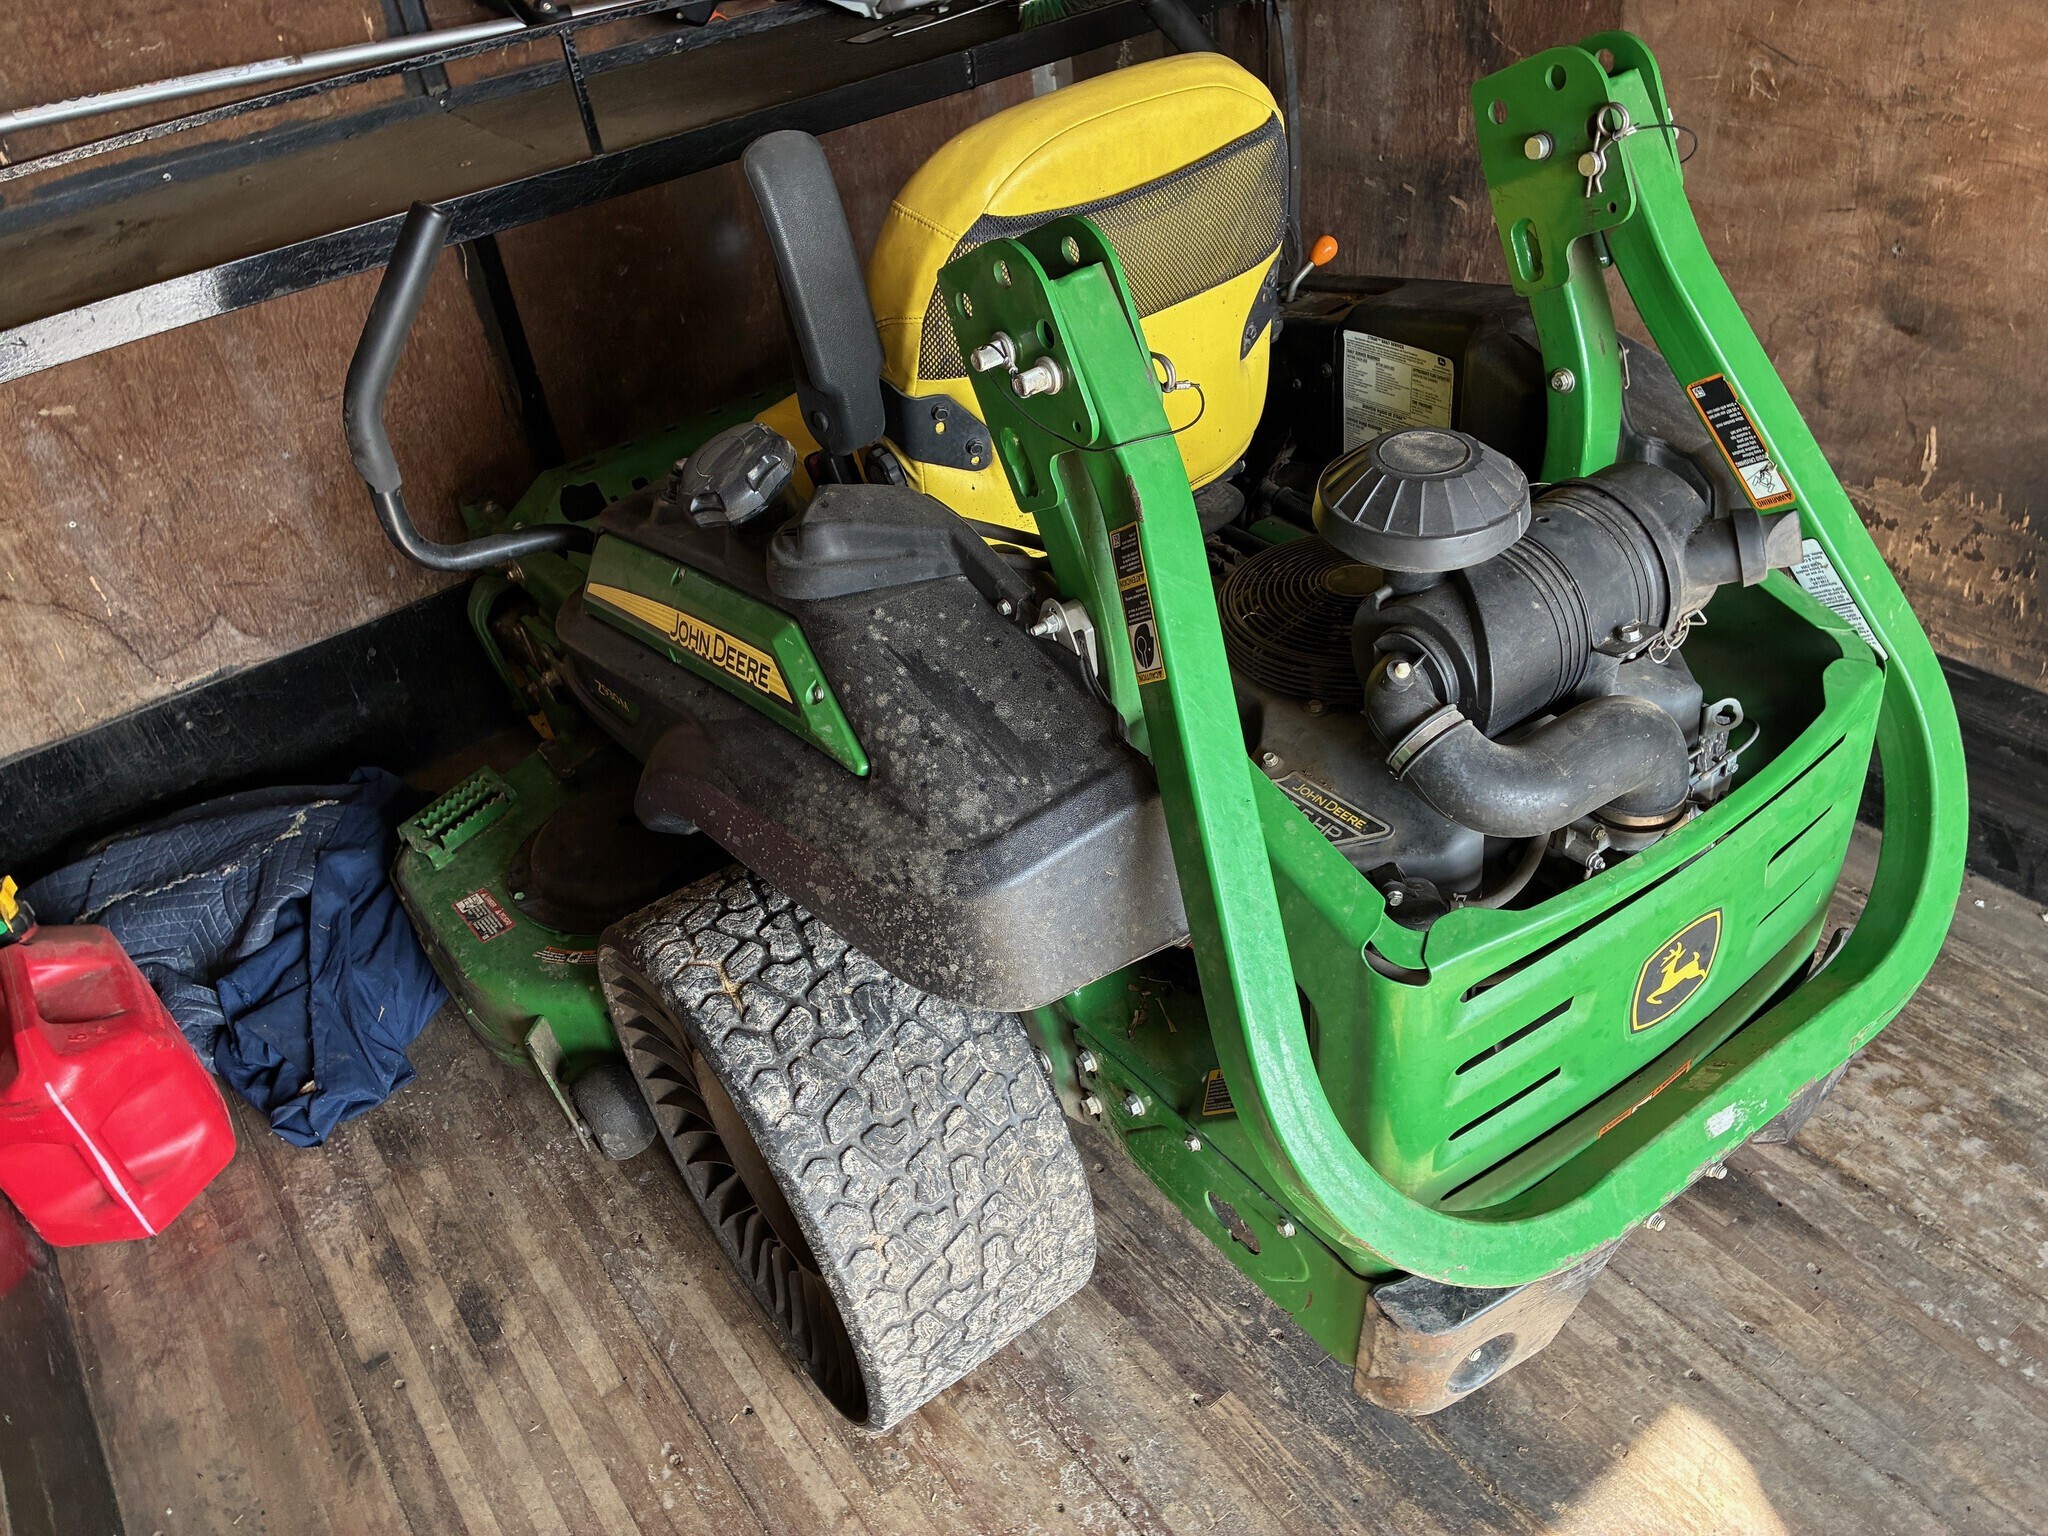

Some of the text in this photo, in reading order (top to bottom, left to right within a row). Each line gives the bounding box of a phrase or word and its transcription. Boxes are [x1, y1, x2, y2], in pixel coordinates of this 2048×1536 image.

[1756, 495, 1786, 507] WARNING
[670, 612, 771, 690] JOHN DEERE
[1292, 784, 1326, 806] JOHN
[1324, 800, 1367, 829] DEERE
